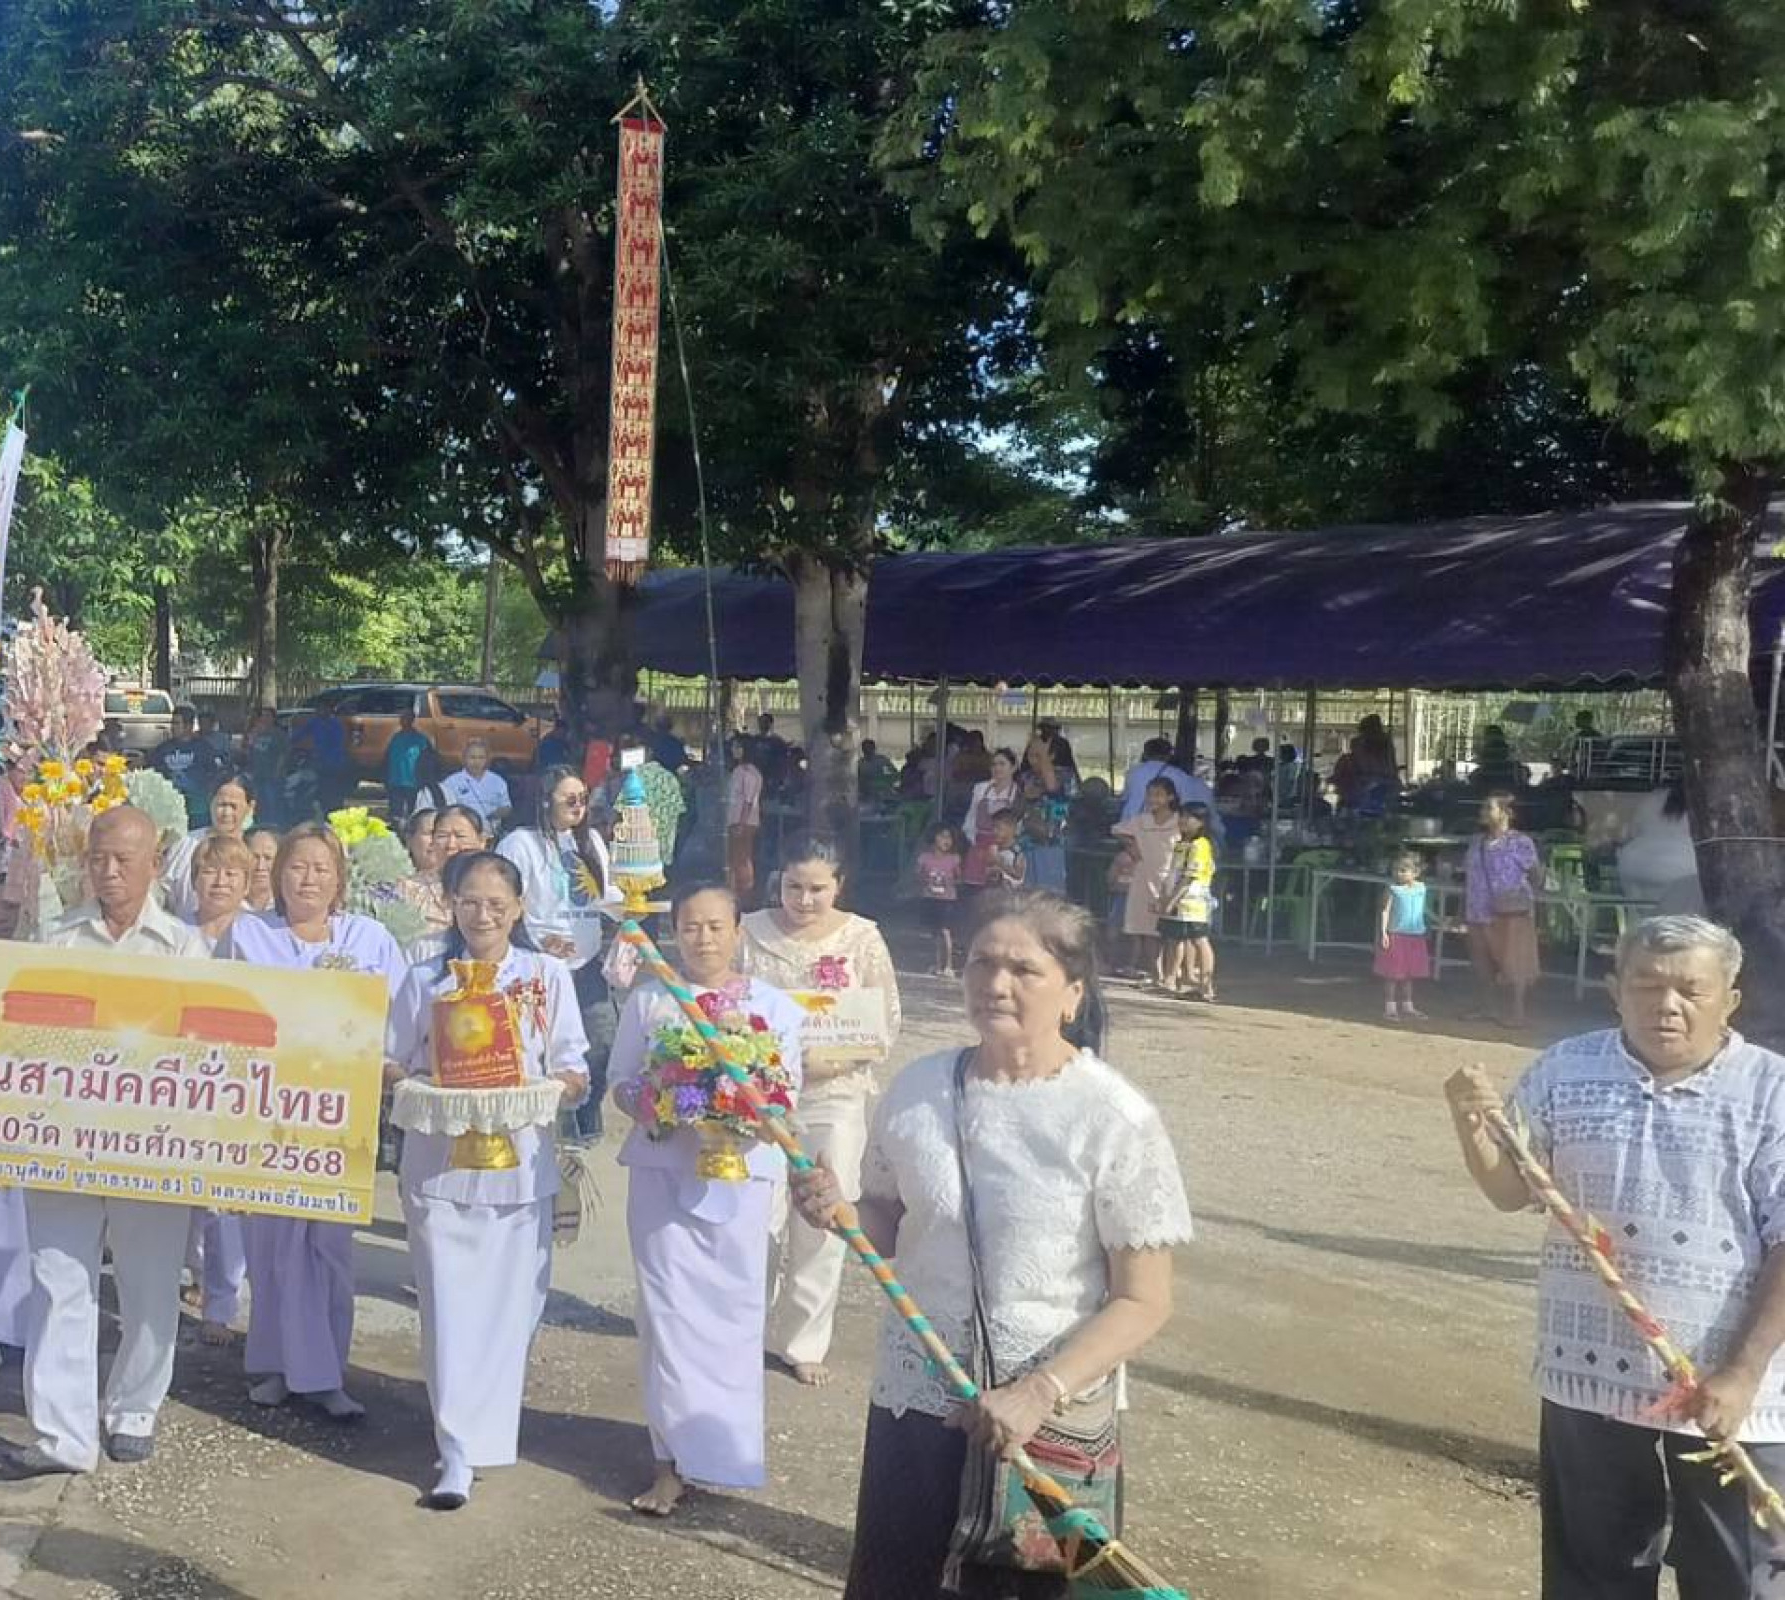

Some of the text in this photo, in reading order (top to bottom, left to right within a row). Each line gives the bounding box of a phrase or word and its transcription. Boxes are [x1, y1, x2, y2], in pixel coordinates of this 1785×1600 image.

[74, 1121, 248, 1166] พุทธศักราช
[261, 1143, 342, 1176] 2568
[161, 1177, 182, 1194] 81
[191, 1176, 203, 1196] ปี
